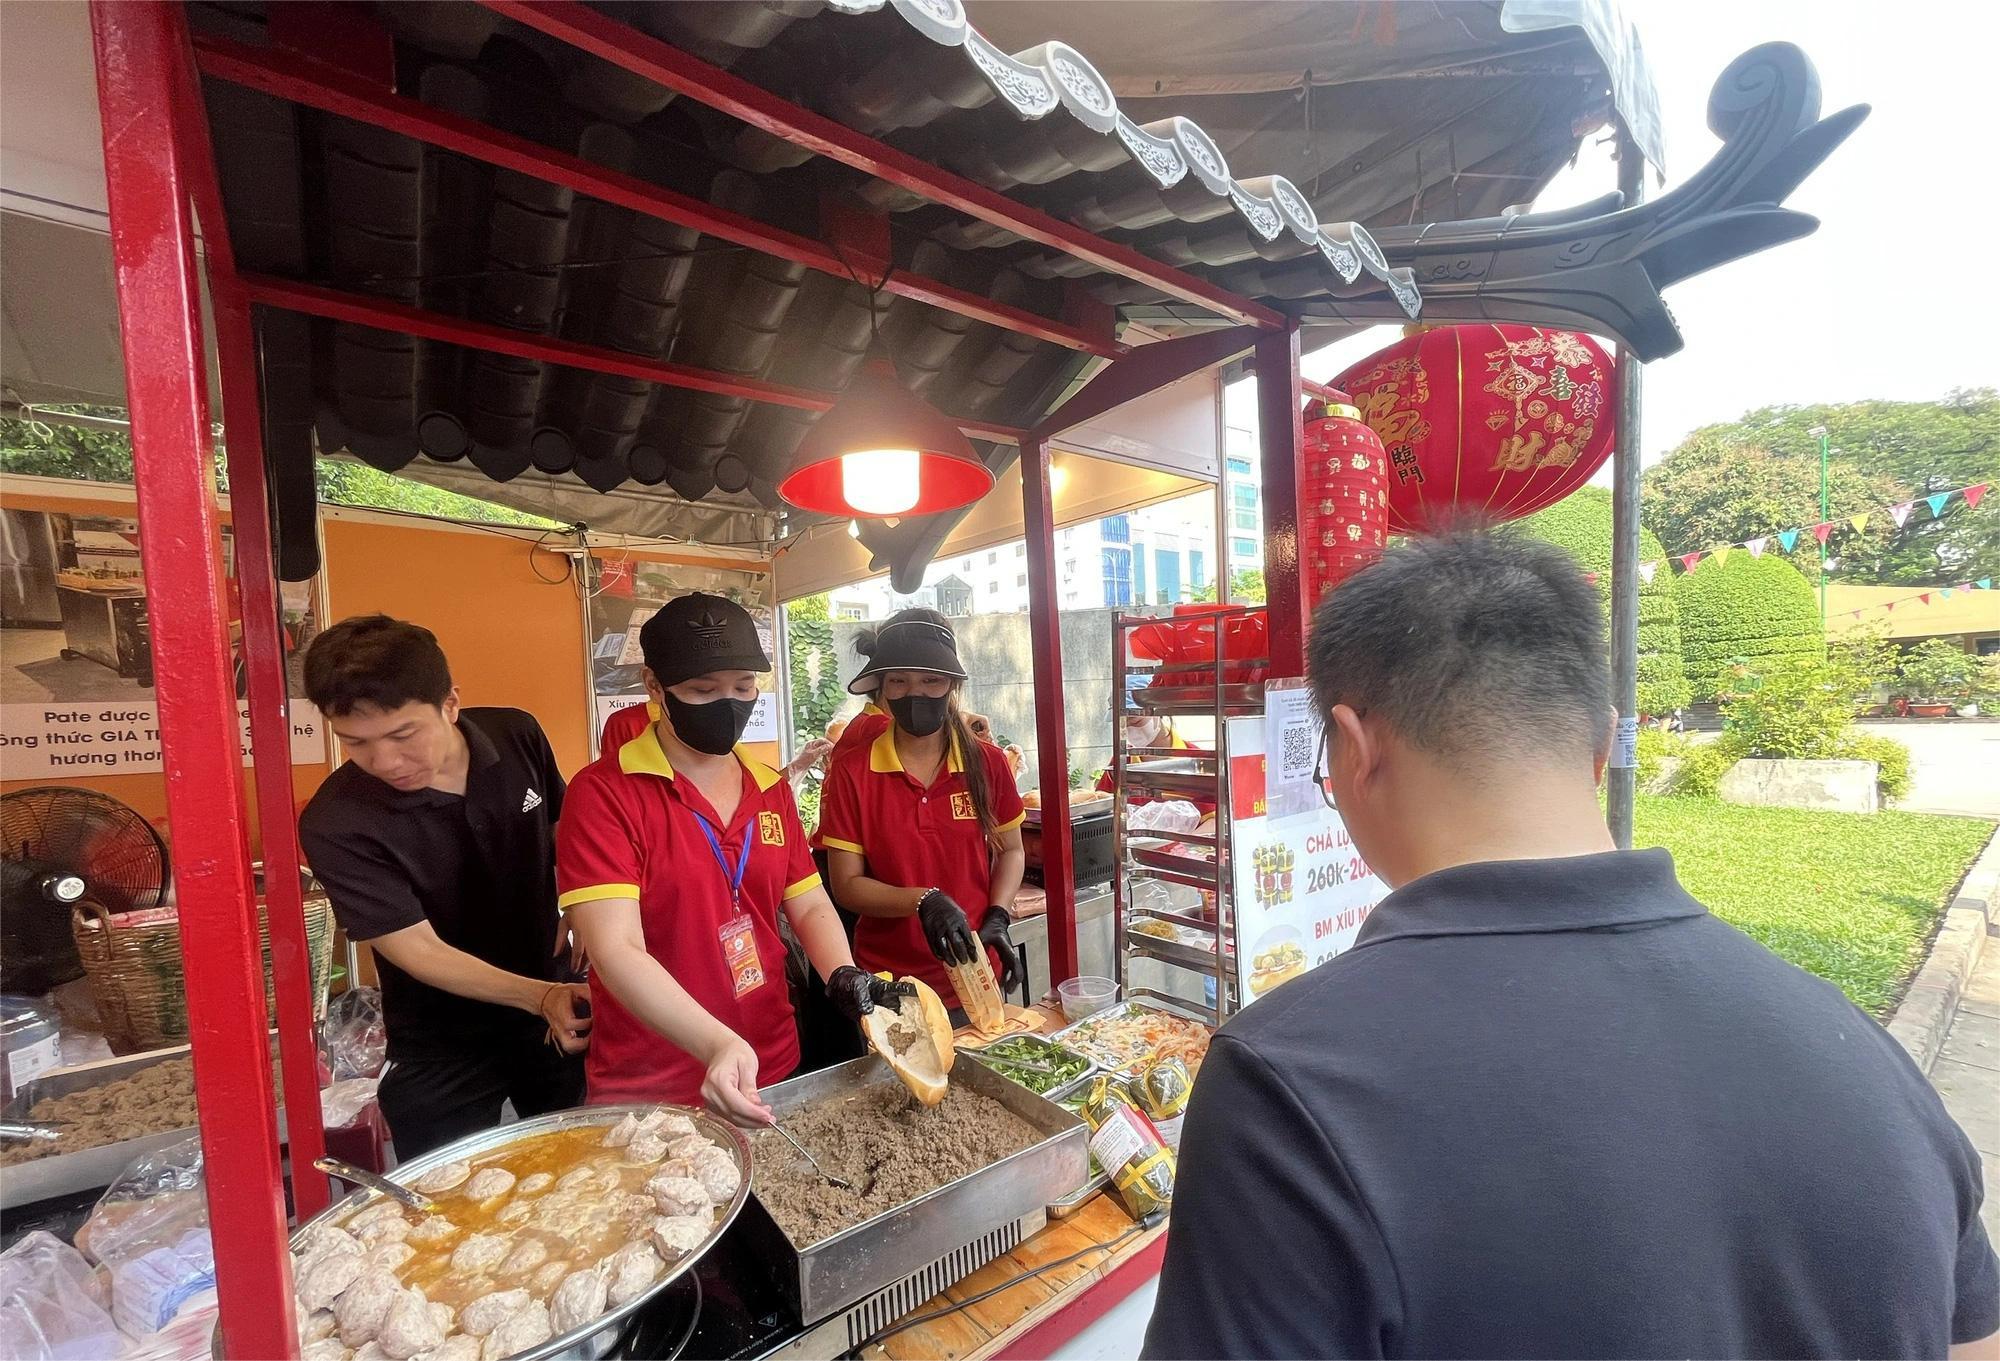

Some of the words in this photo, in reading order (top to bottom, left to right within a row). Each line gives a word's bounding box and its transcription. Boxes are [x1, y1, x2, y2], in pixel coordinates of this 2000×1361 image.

[1539, 365, 1578, 401] 喜
[44, 711, 92, 723] Pate
[99, 710, 151, 725] được
[0, 734, 38, 748] ông
[46, 731, 93, 744] thức
[100, 730, 138, 742] GIA
[294, 724, 314, 737] hệ
[50, 752, 118, 766] hương
[1306, 826, 1333, 854] CHẢ
[1337, 829, 1353, 851] LỤ
[1315, 918, 1333, 940] BM
[1336, 907, 1355, 933] XÍU
